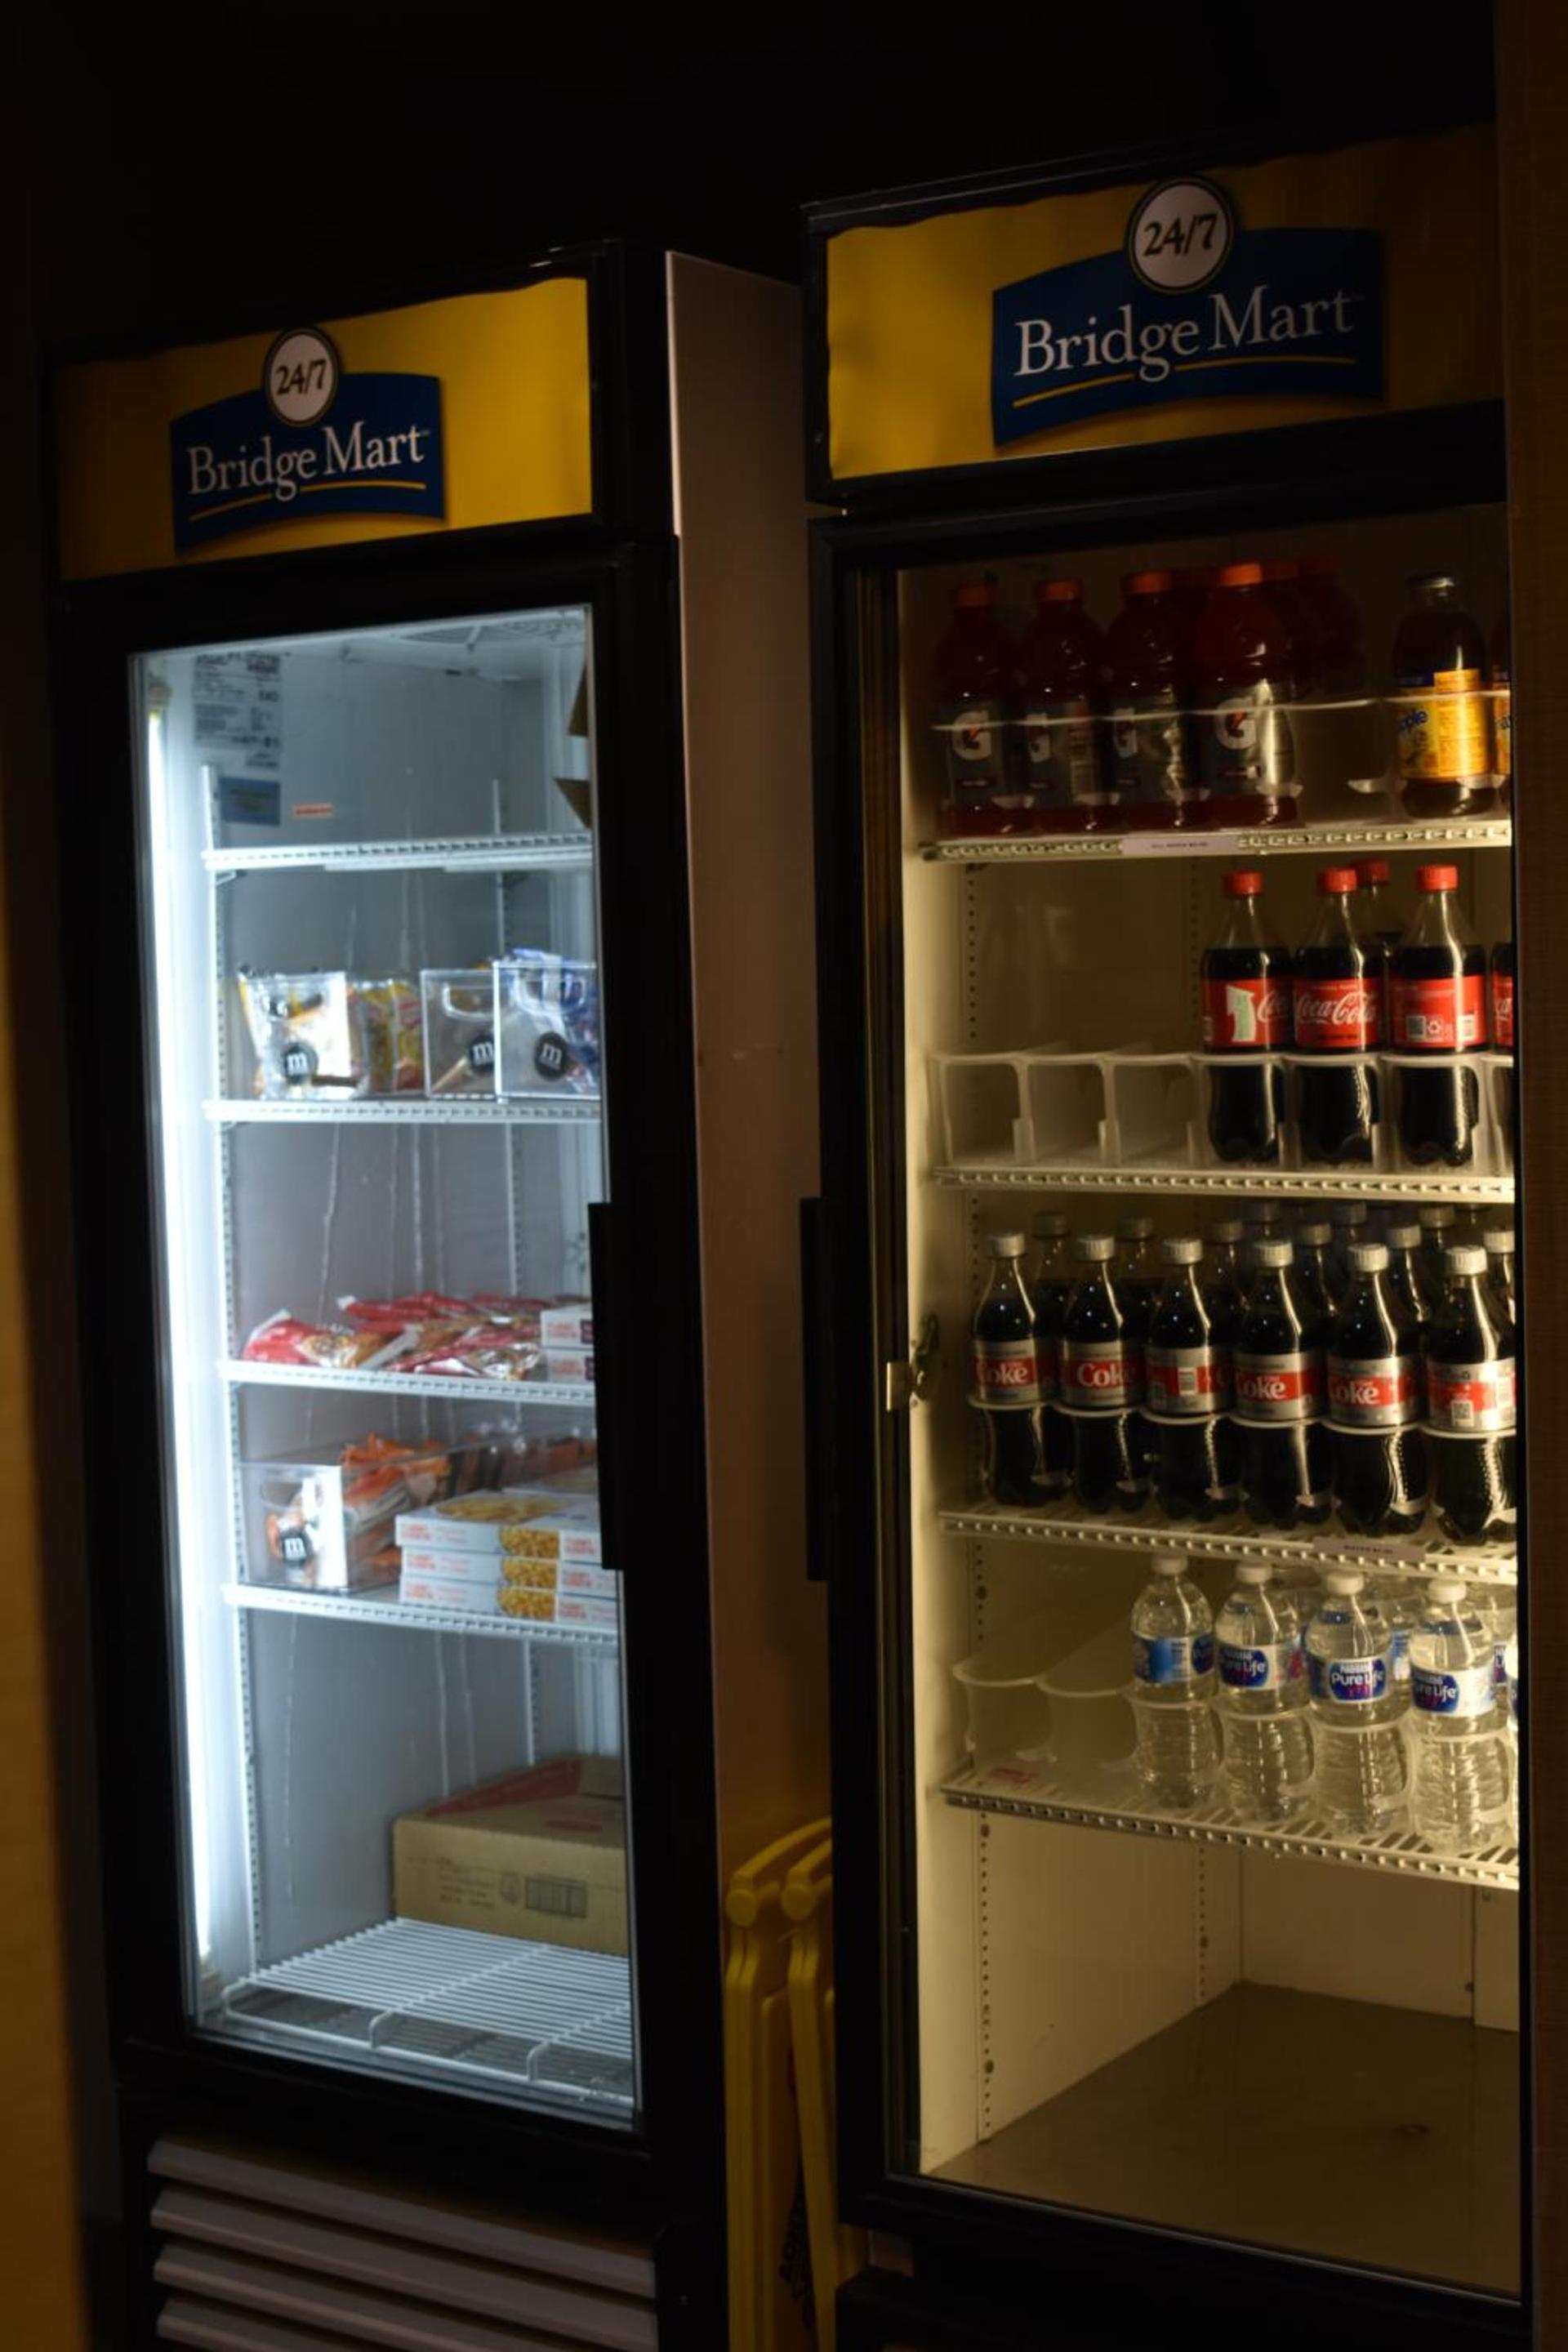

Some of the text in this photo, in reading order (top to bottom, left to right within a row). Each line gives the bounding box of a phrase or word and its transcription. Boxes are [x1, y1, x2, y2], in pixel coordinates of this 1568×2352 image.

[1144, 213, 1218, 256] 24/7
[1013, 285, 1355, 382] Bridge Mart
[276, 359, 327, 395] 24/7
[187, 421, 425, 501] Bridge Mart
[541, 1042, 560, 1064] m
[1077, 1362, 1131, 1388] Cok
[1239, 1375, 1287, 1400] oke
[1331, 1672, 1363, 1686] Pure
